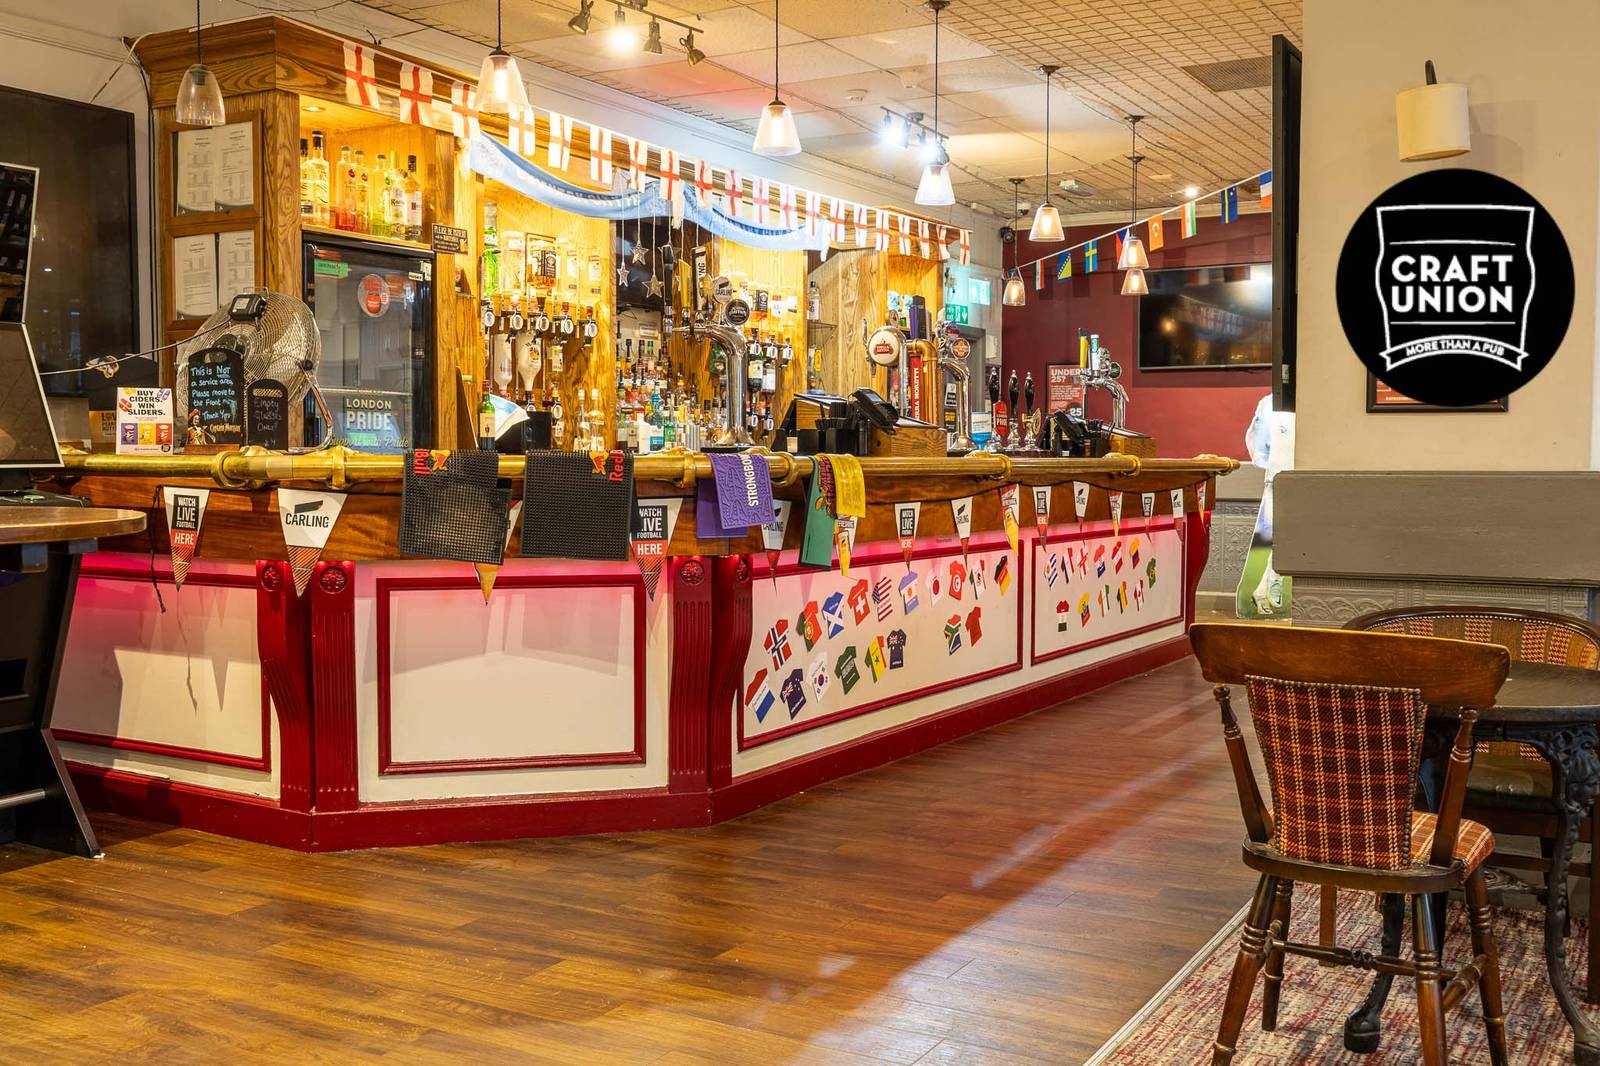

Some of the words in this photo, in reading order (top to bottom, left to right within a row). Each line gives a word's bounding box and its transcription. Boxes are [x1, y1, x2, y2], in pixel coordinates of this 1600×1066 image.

[190, 366, 206, 377] This
[1051, 368, 1080, 376] UNDER
[1051, 375, 1066, 383] 25?
[191, 389, 210, 398] Please
[346, 398, 392, 410] LONDON
[1069, 407, 1083, 417] 25
[346, 411, 392, 430] PRIDE
[177, 496, 196, 507] WATCH
[176, 506, 196, 522] LIVE
[175, 520, 196, 529] FOOTBALL
[285, 513, 329, 528] CARLING
[642, 517, 663, 532] IVE
[173, 532, 195, 545] HERE
[637, 543, 663, 555] HERE
